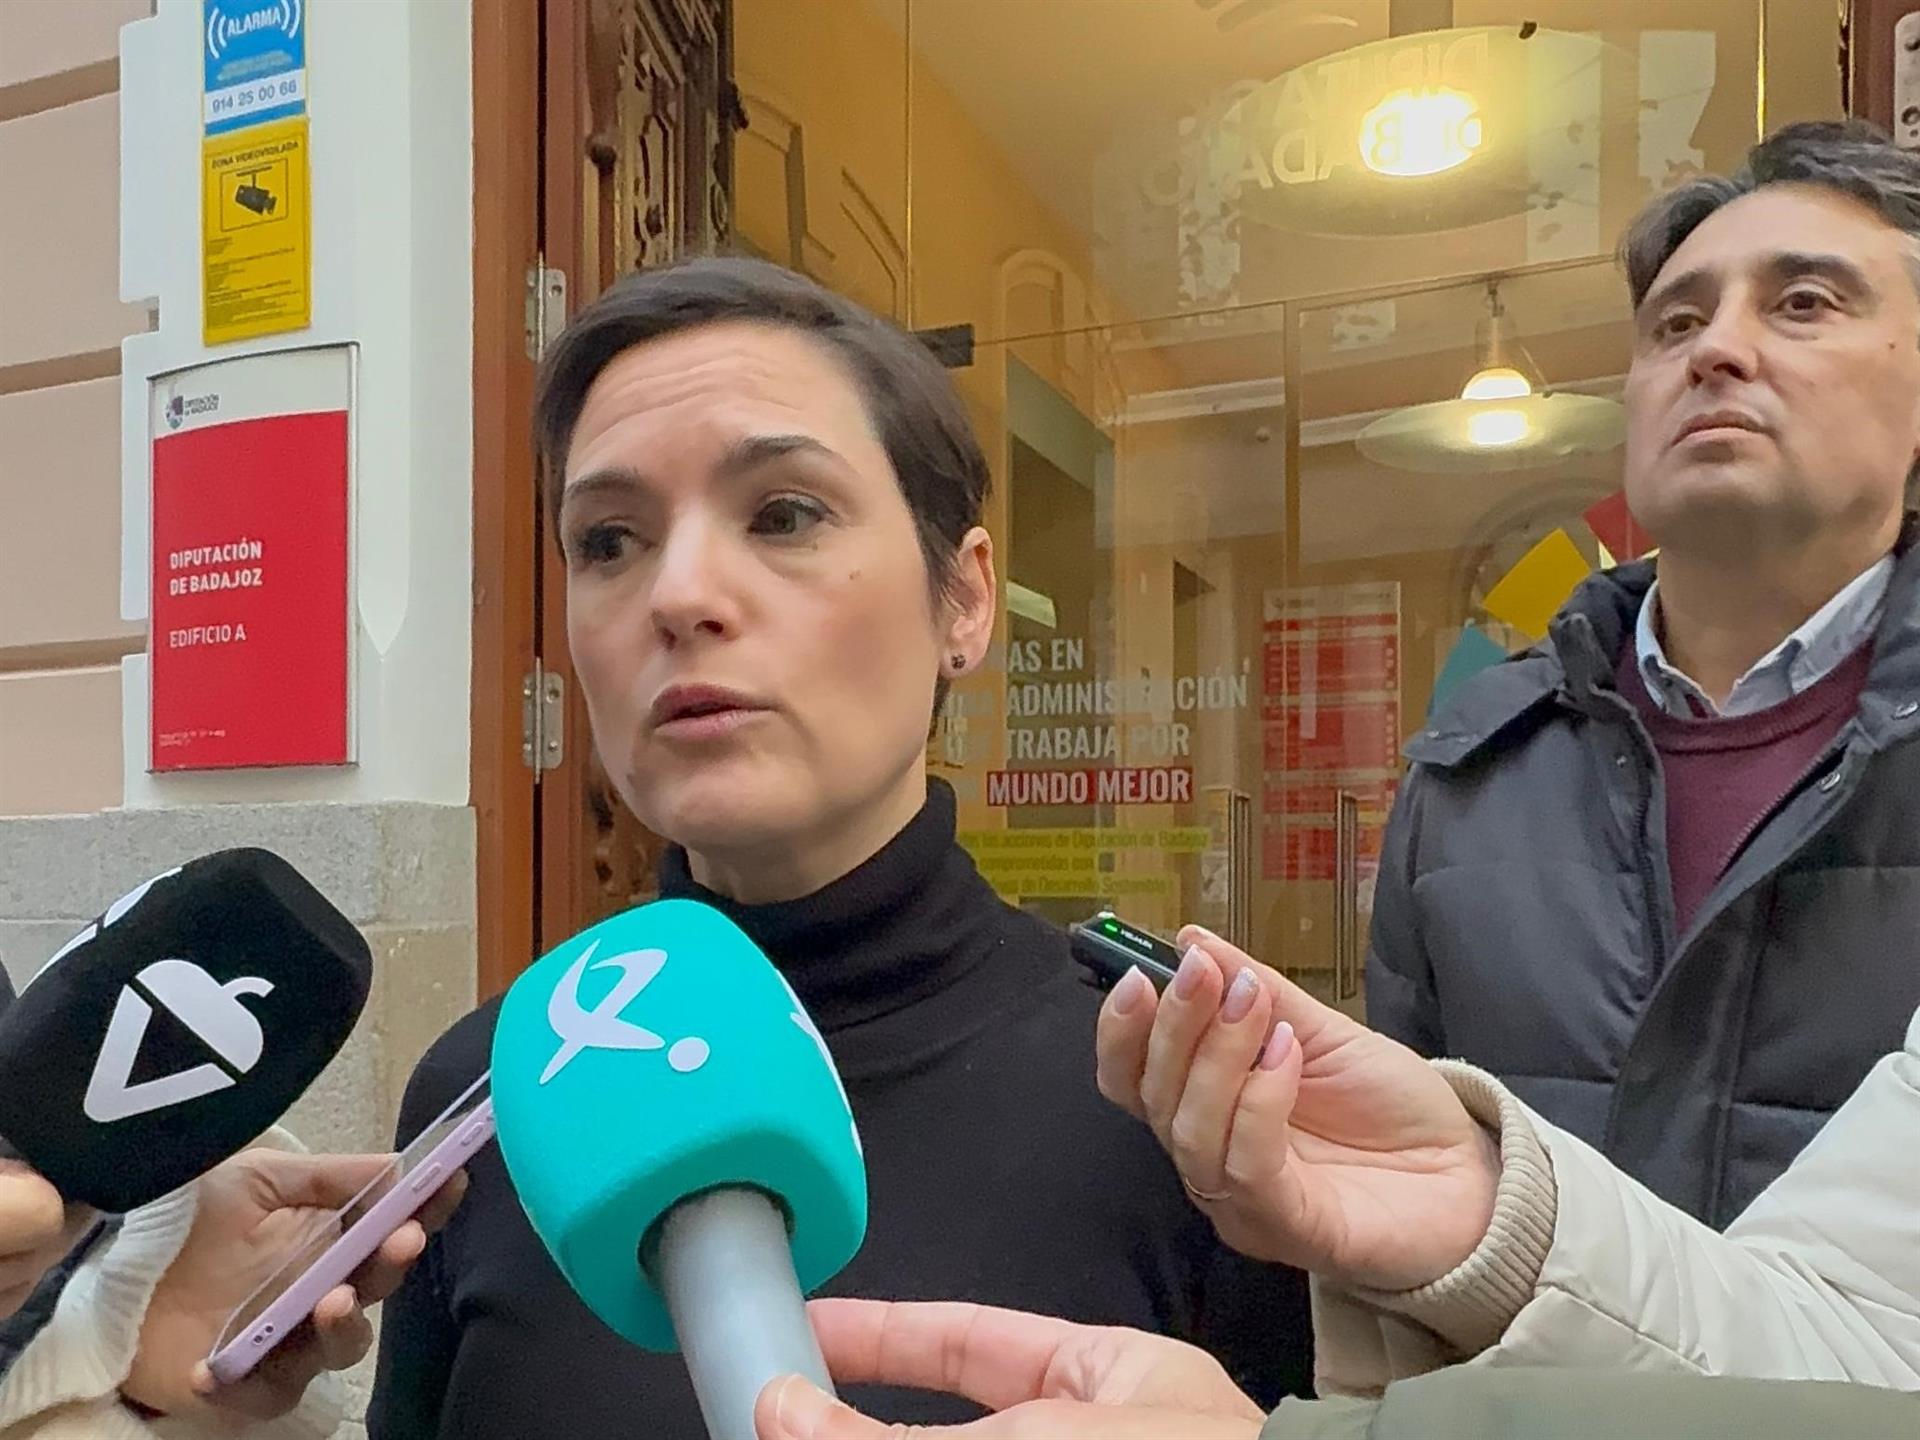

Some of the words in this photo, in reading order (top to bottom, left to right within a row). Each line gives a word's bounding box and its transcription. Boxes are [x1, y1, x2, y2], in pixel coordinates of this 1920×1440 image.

[227, 7, 281, 38] ALARMA
[258, 84, 275, 101] 00
[170, 537, 262, 570] DIPUTACIÓN
[170, 577, 187, 596] DE
[190, 568, 262, 593] BADAJOZ
[170, 625, 231, 648] EDIFICIO
[235, 623, 247, 641] A
[1050, 638, 1084, 671] EN
[1007, 725, 1120, 760] TRABAJA
[1131, 723, 1190, 757] POR
[989, 771, 1088, 805] MUNDO
[1098, 769, 1190, 803] MEJOR
